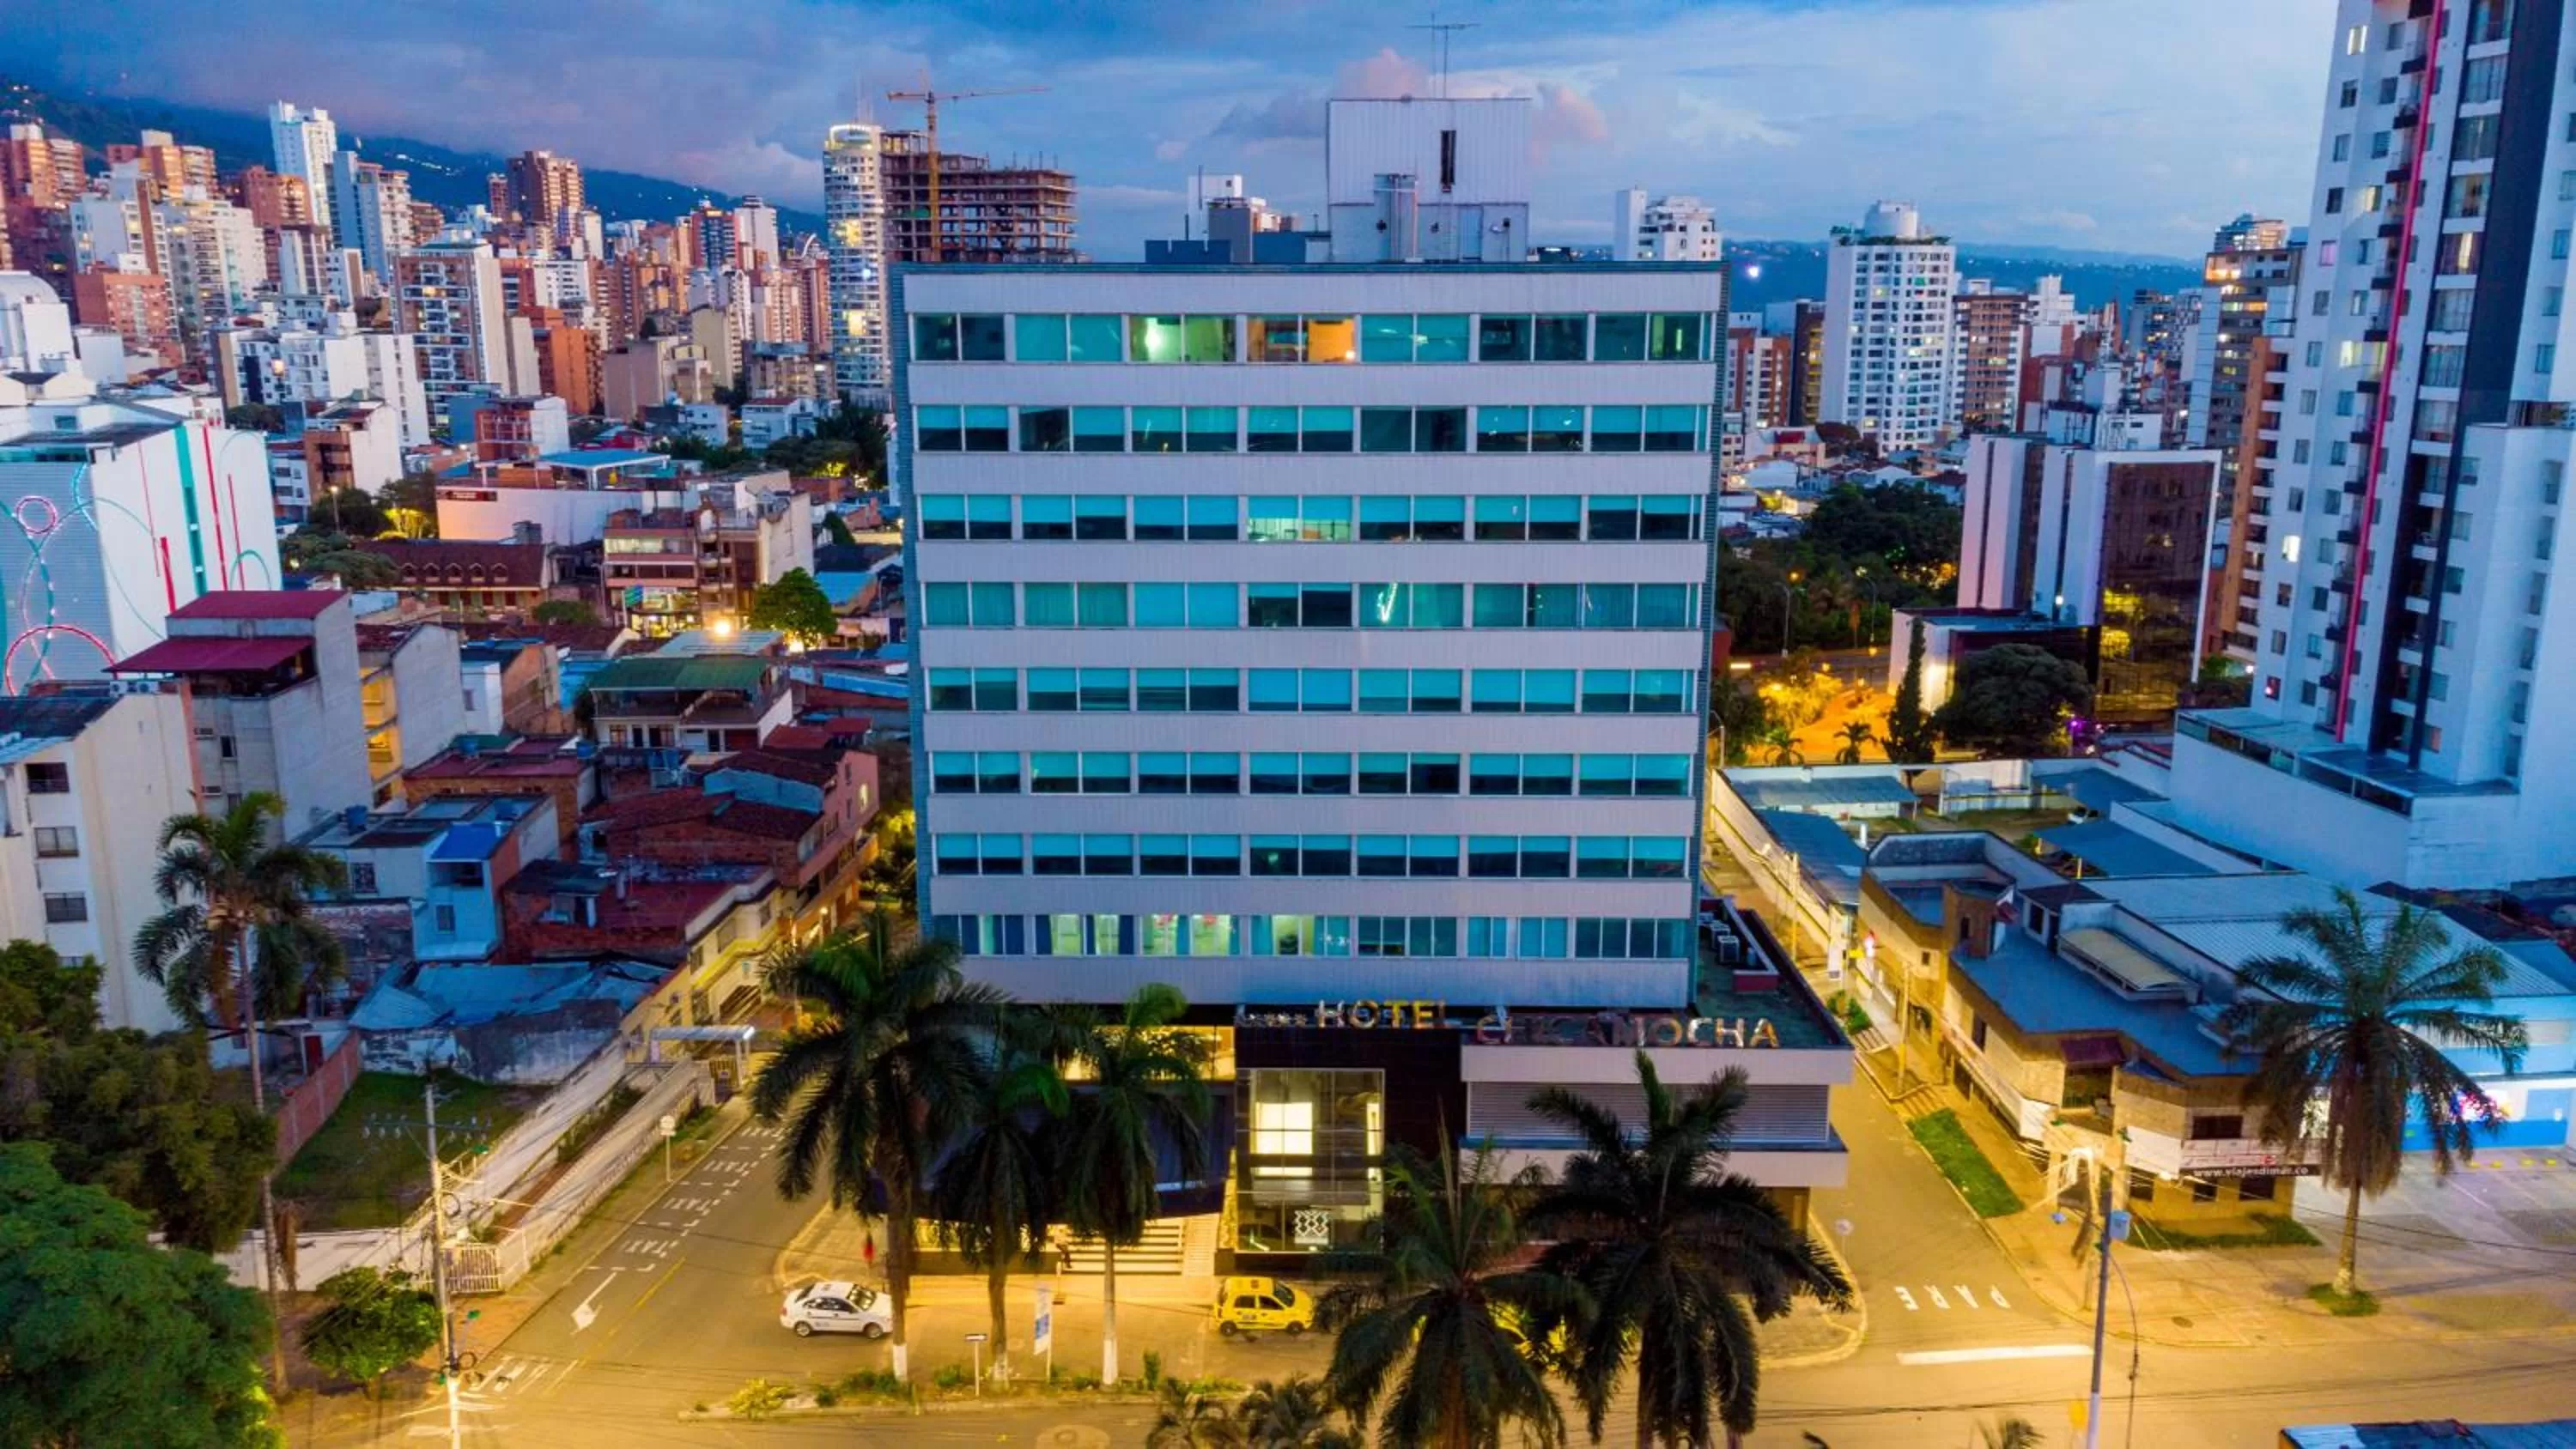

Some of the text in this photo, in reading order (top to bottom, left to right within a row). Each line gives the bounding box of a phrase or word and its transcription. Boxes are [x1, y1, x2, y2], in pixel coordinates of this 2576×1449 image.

[1315, 999, 1461, 1029] HOTEL
[702, 1161, 750, 1173] TAXI
[662, 1198, 711, 1211] TAXI
[619, 1240, 668, 1254] TAXI
[1894, 1285, 2011, 1311] PARE
